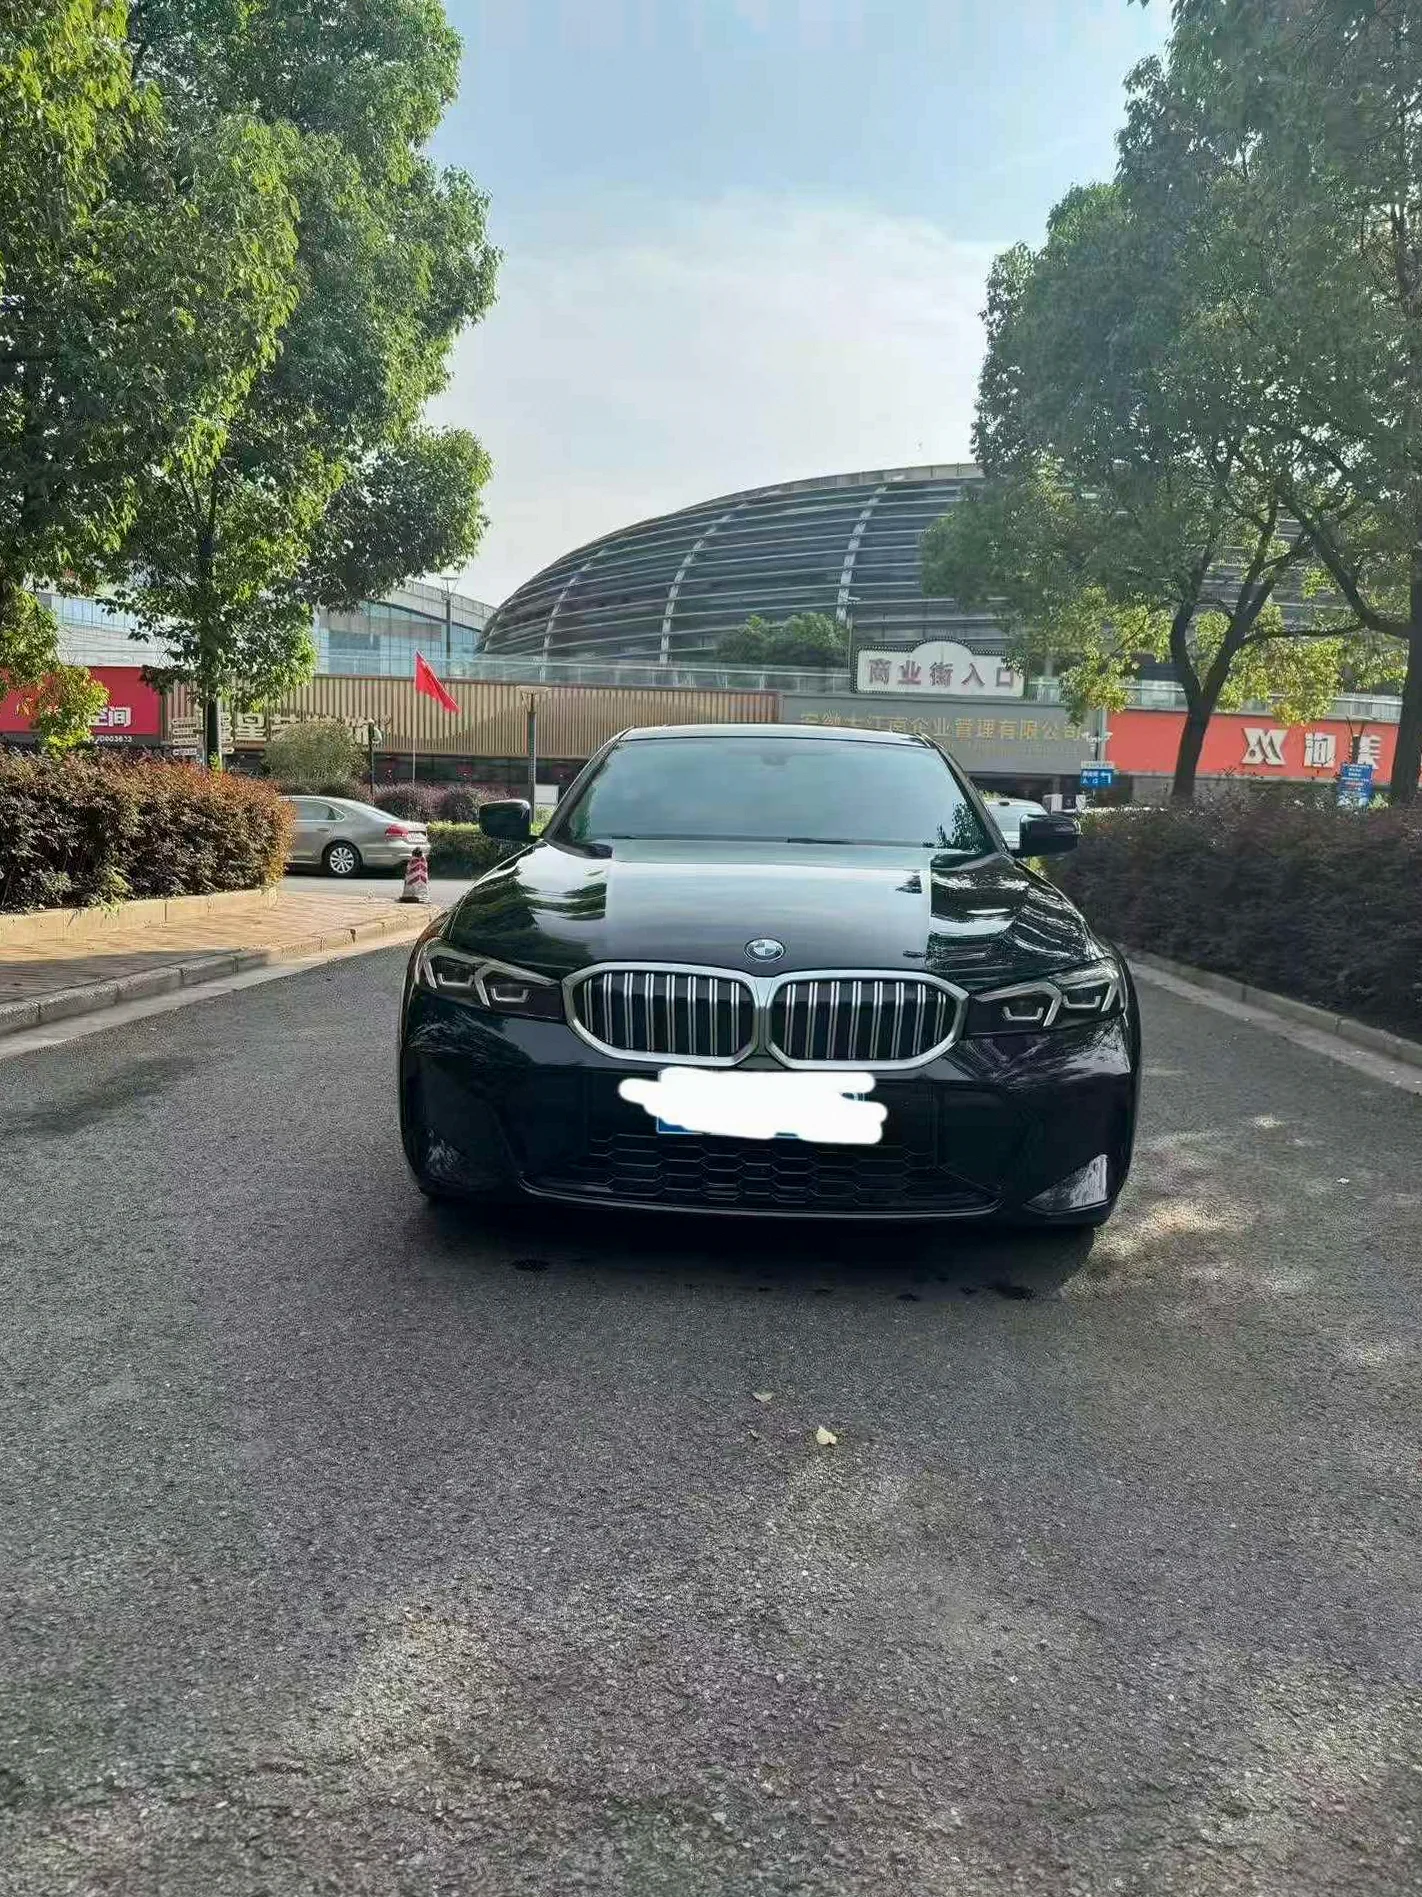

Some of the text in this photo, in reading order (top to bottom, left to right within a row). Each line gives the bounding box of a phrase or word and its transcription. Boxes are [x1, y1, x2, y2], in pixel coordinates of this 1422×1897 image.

[869, 658, 1014, 688] 商业街入口
